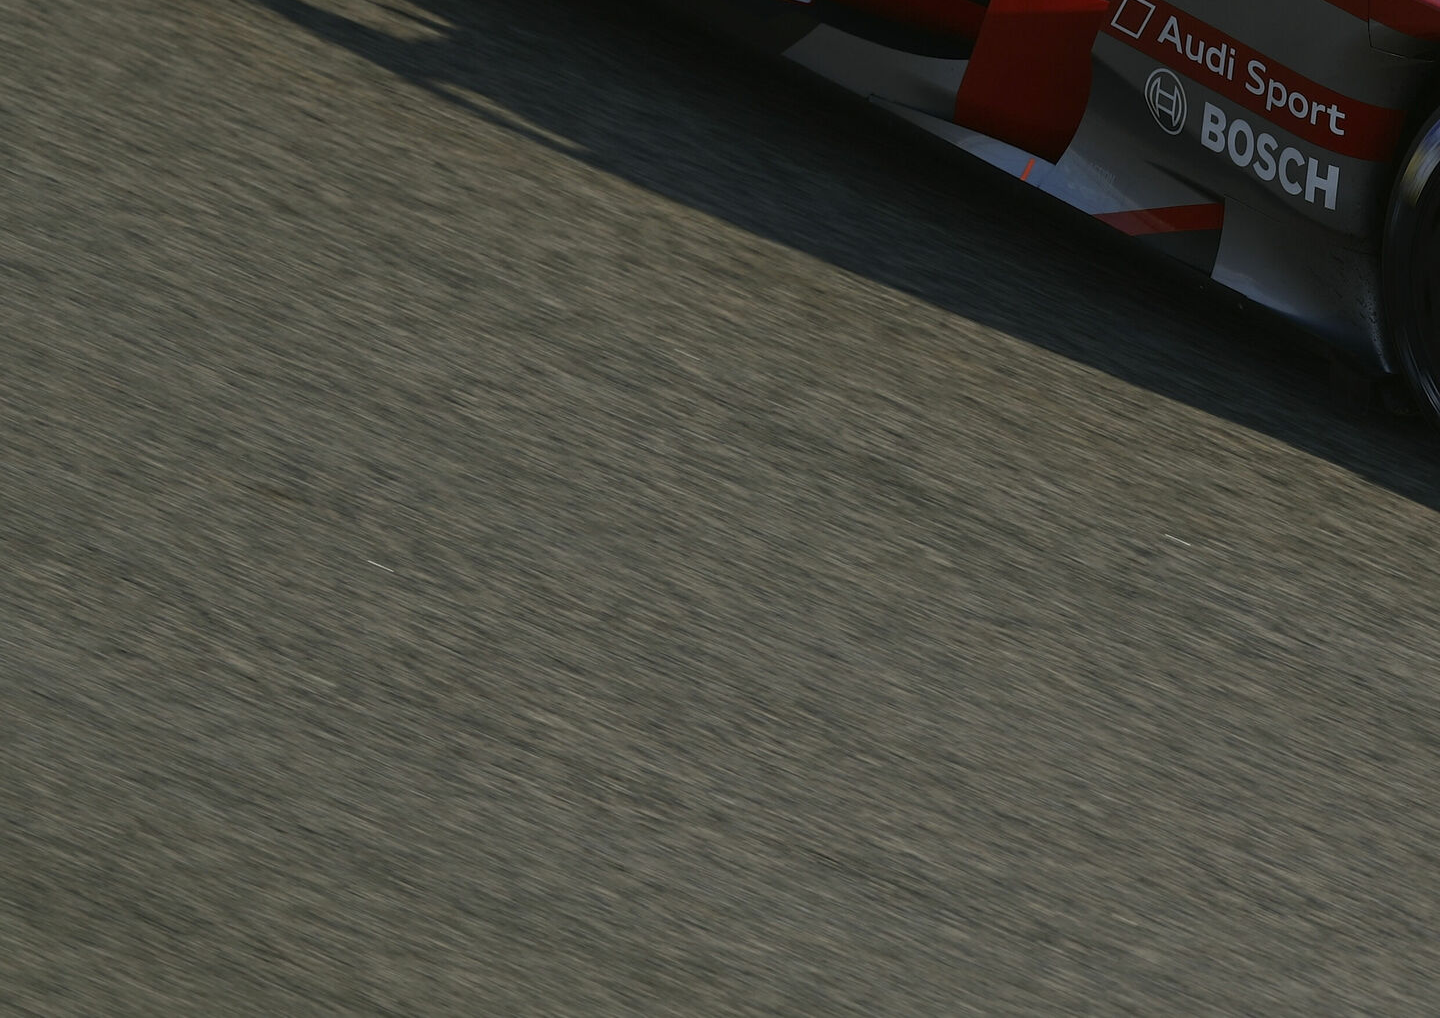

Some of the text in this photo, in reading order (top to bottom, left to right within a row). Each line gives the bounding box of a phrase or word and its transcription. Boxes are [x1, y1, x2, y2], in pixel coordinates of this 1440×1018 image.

[1157, 16, 1346, 136] Audi Sport
[1201, 101, 1340, 211] BOSCH
